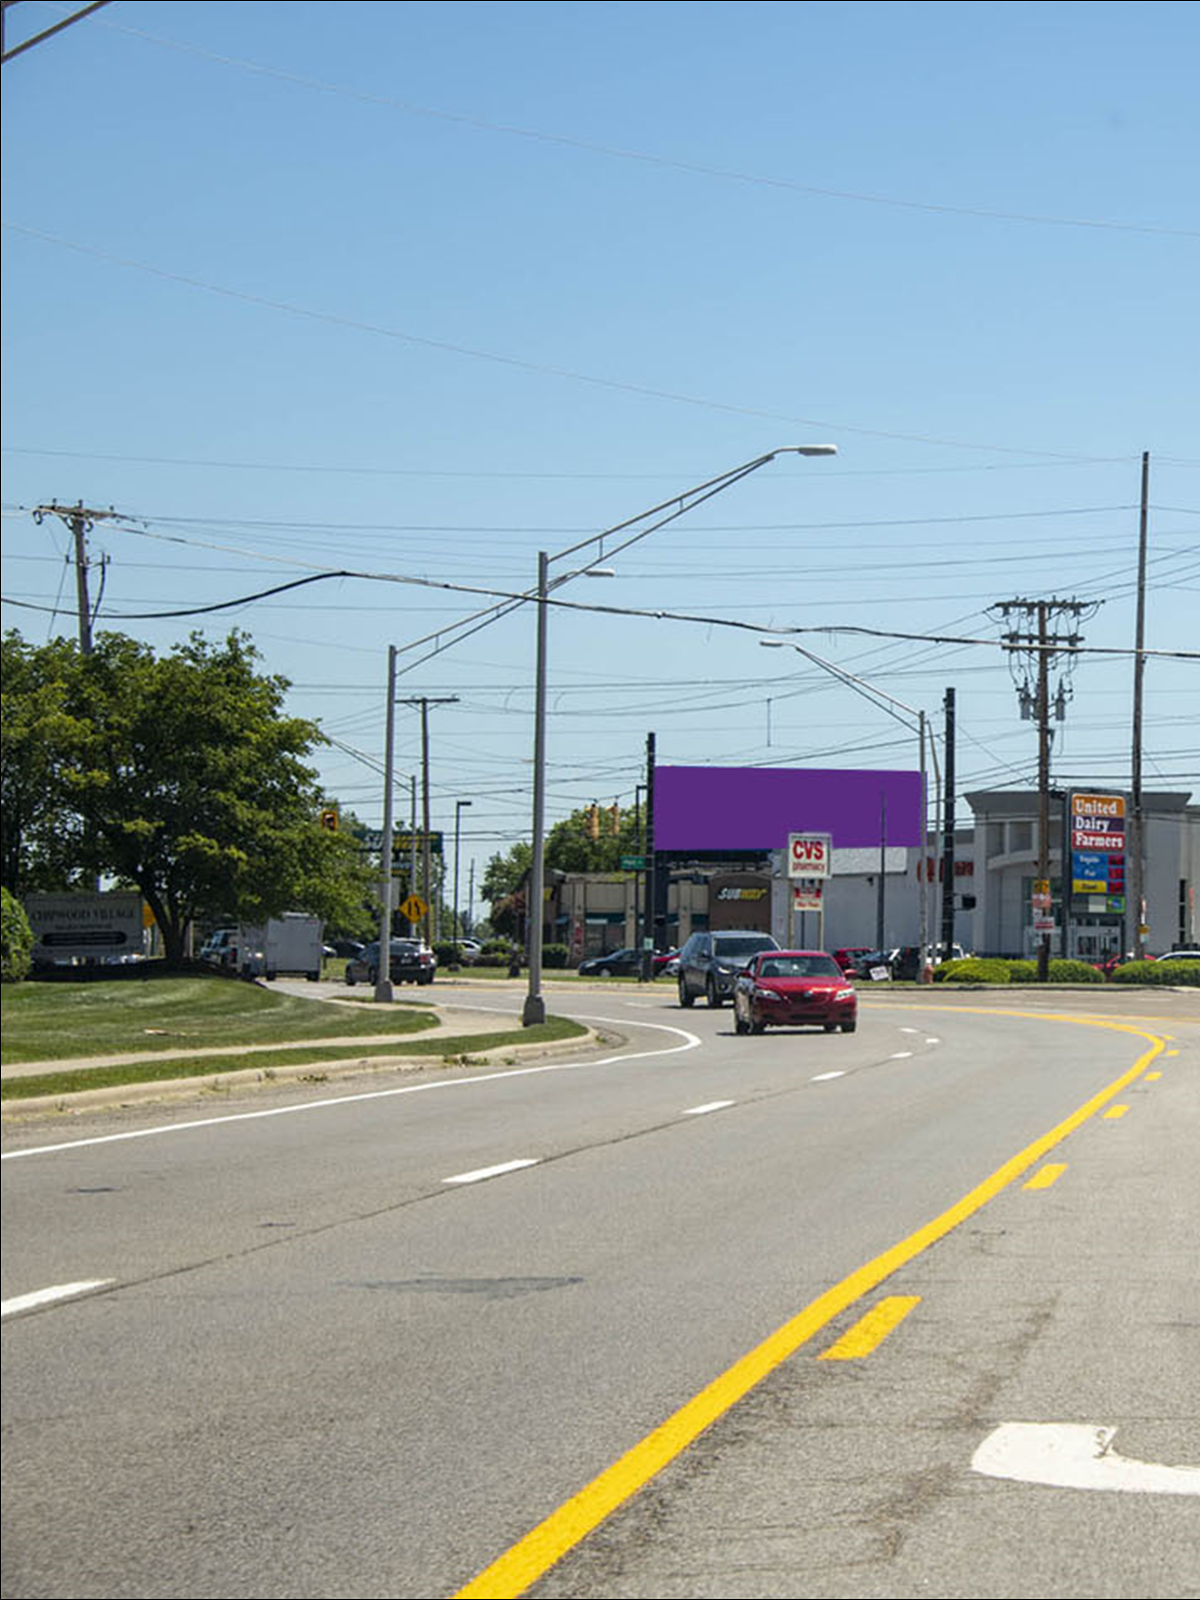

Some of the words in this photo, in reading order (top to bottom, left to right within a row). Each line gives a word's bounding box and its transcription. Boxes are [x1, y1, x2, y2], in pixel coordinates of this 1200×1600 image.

[1076, 800, 1117, 815] United
[1075, 816, 1110, 832] Dairy
[1075, 832, 1123, 848] Farmers
[793, 839, 824, 860] CVS
[793, 862, 825, 873] pharmacy
[717, 888, 767, 900] SUBWAY
